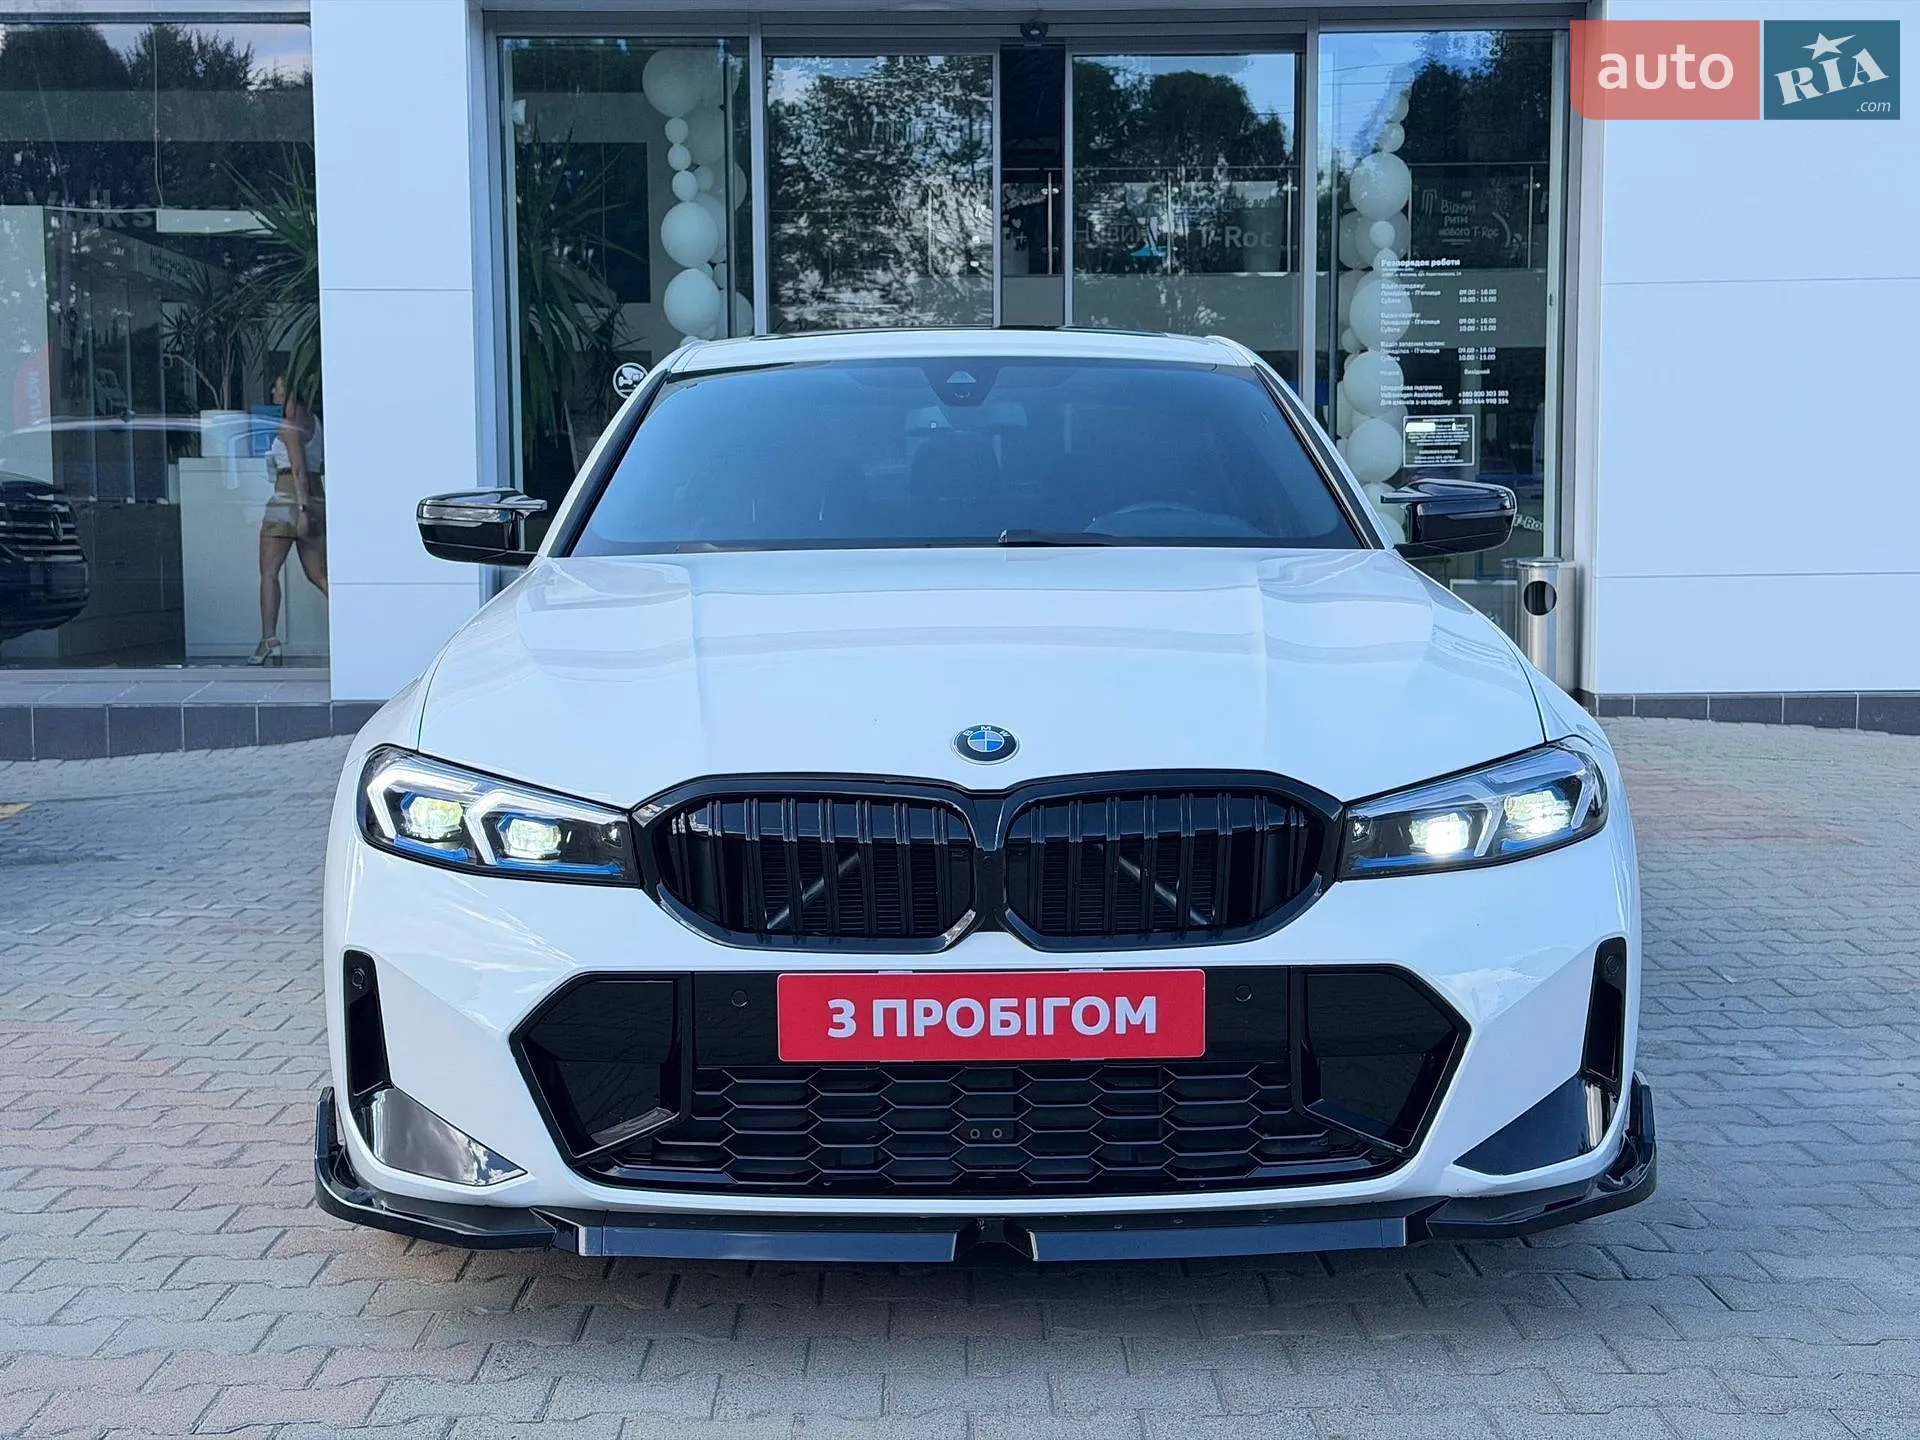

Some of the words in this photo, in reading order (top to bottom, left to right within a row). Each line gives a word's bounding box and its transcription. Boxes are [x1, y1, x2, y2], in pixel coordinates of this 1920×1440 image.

[1200, 224, 1274, 249] T-Roc
[1430, 257, 1461, 268] роботи
[963, 726, 1011, 737] BMW
[872, 995, 1158, 1038] ПРОБІГОМ
